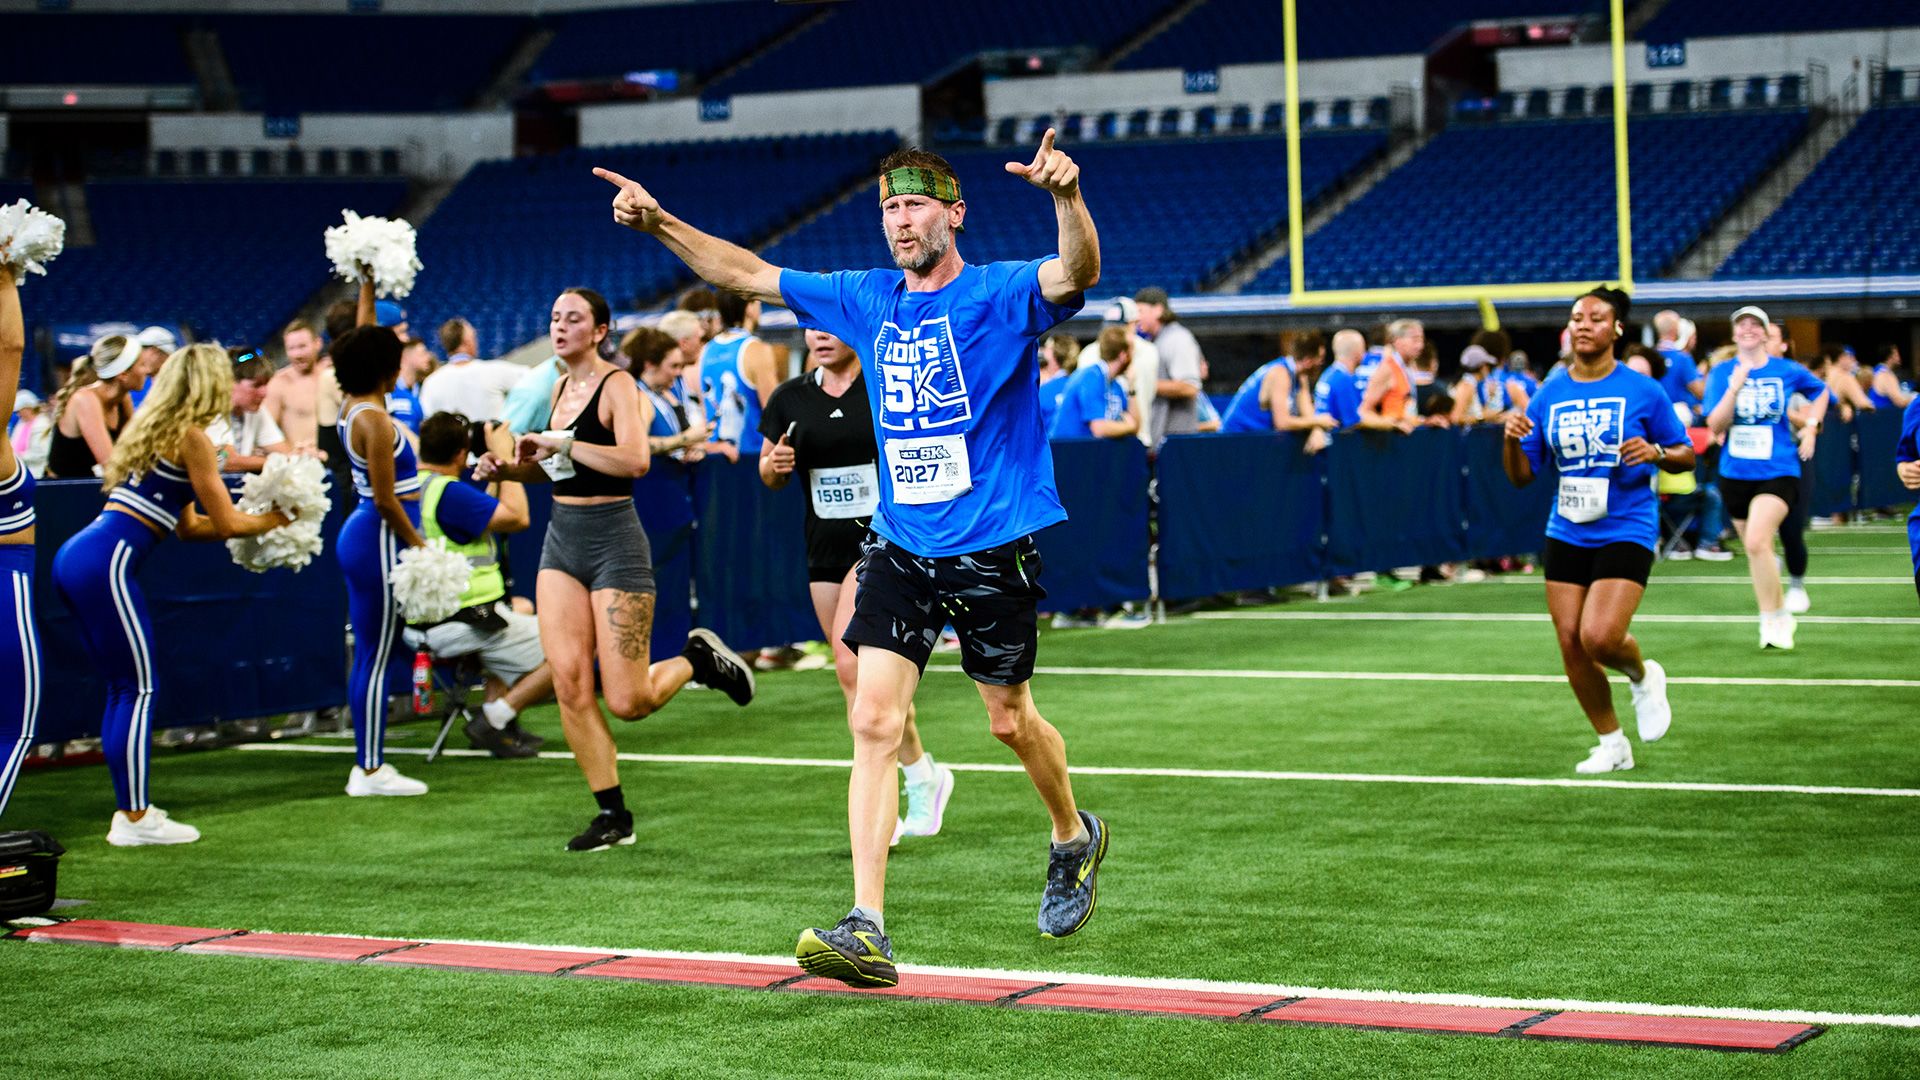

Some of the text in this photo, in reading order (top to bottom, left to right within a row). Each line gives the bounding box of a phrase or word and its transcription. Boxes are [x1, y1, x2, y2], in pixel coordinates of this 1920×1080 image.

[882, 361, 943, 413] 5K
[1559, 408, 1612, 426] COLTS
[1558, 422, 1611, 459] 5K
[920, 445, 945, 461] 5K
[895, 464, 939, 483] 2027
[817, 488, 854, 503] 1596
